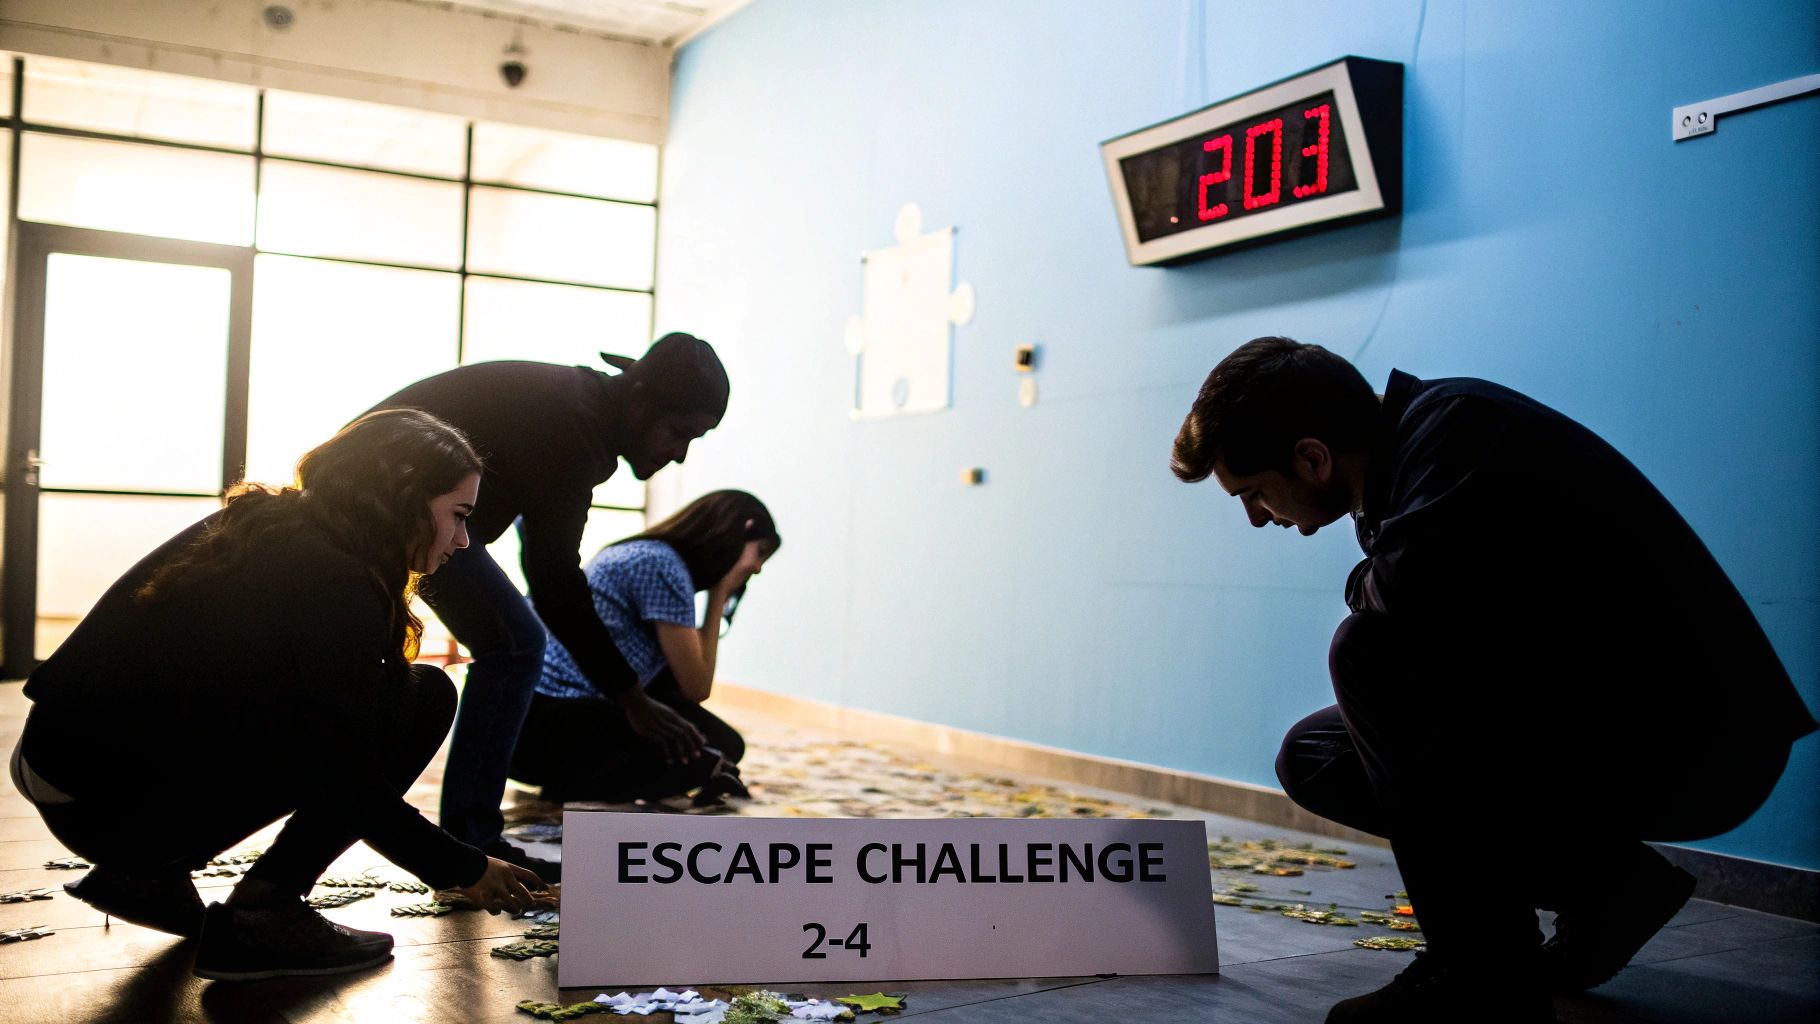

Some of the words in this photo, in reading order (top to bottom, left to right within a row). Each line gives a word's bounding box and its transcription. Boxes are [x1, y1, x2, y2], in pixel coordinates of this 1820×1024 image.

[617, 841, 834, 885] ESCAPE
[856, 841, 1167, 885] CHALLENGE
[801, 922, 872, 960] 2-4
